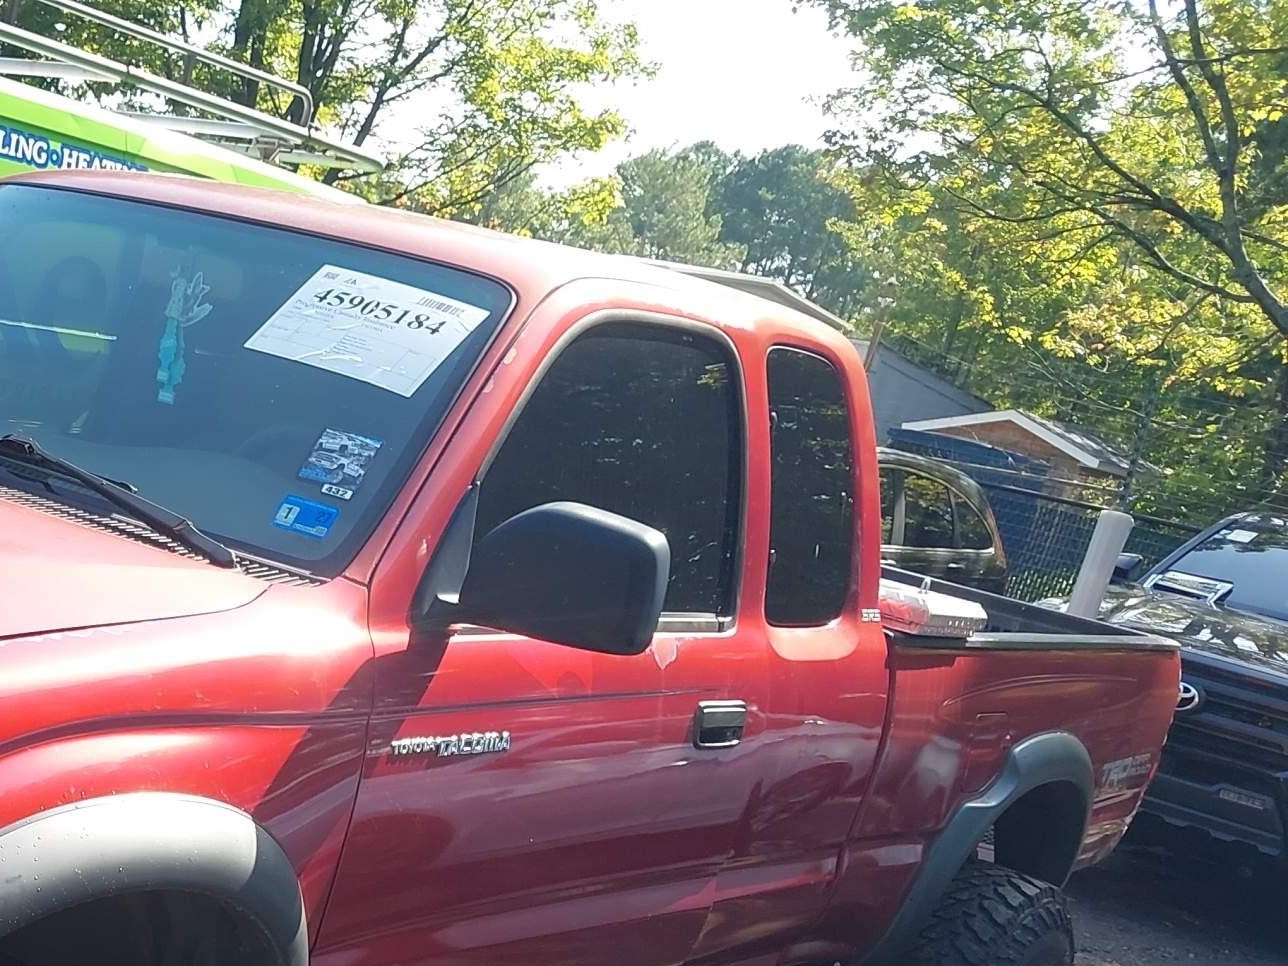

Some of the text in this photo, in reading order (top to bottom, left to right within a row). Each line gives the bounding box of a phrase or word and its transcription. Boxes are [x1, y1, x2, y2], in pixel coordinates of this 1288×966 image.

[60, 146, 137, 172] HEAT
[312, 288, 447, 336] 45905184
[392, 730, 511, 758] TOYOTA TACOMA
